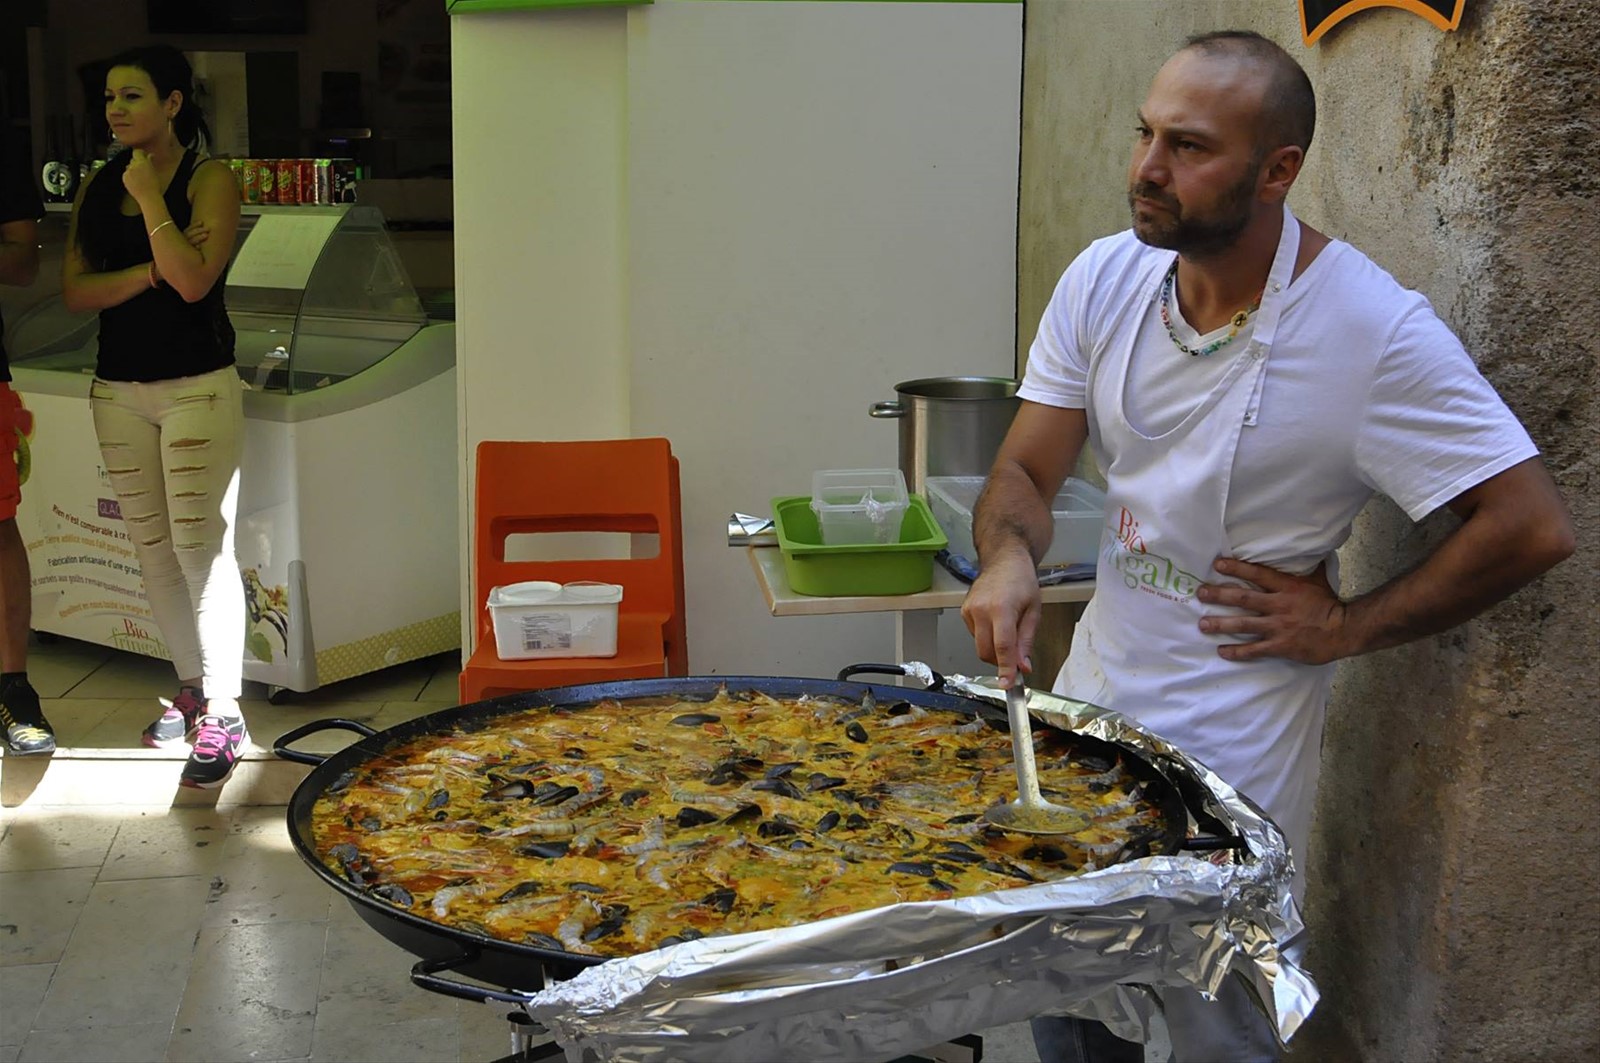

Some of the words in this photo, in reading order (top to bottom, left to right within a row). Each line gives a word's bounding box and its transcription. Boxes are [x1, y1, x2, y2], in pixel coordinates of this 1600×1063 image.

[66, 512, 80, 526] n'est
[80, 520, 113, 537] comparable
[1117, 507, 1147, 555] Bio
[47, 554, 78, 567] Fabrication
[78, 554, 107, 567] artisanale
[107, 559, 124, 571] d'une
[84, 576, 137, 597] remarquablement
[123, 617, 149, 640] Bio
